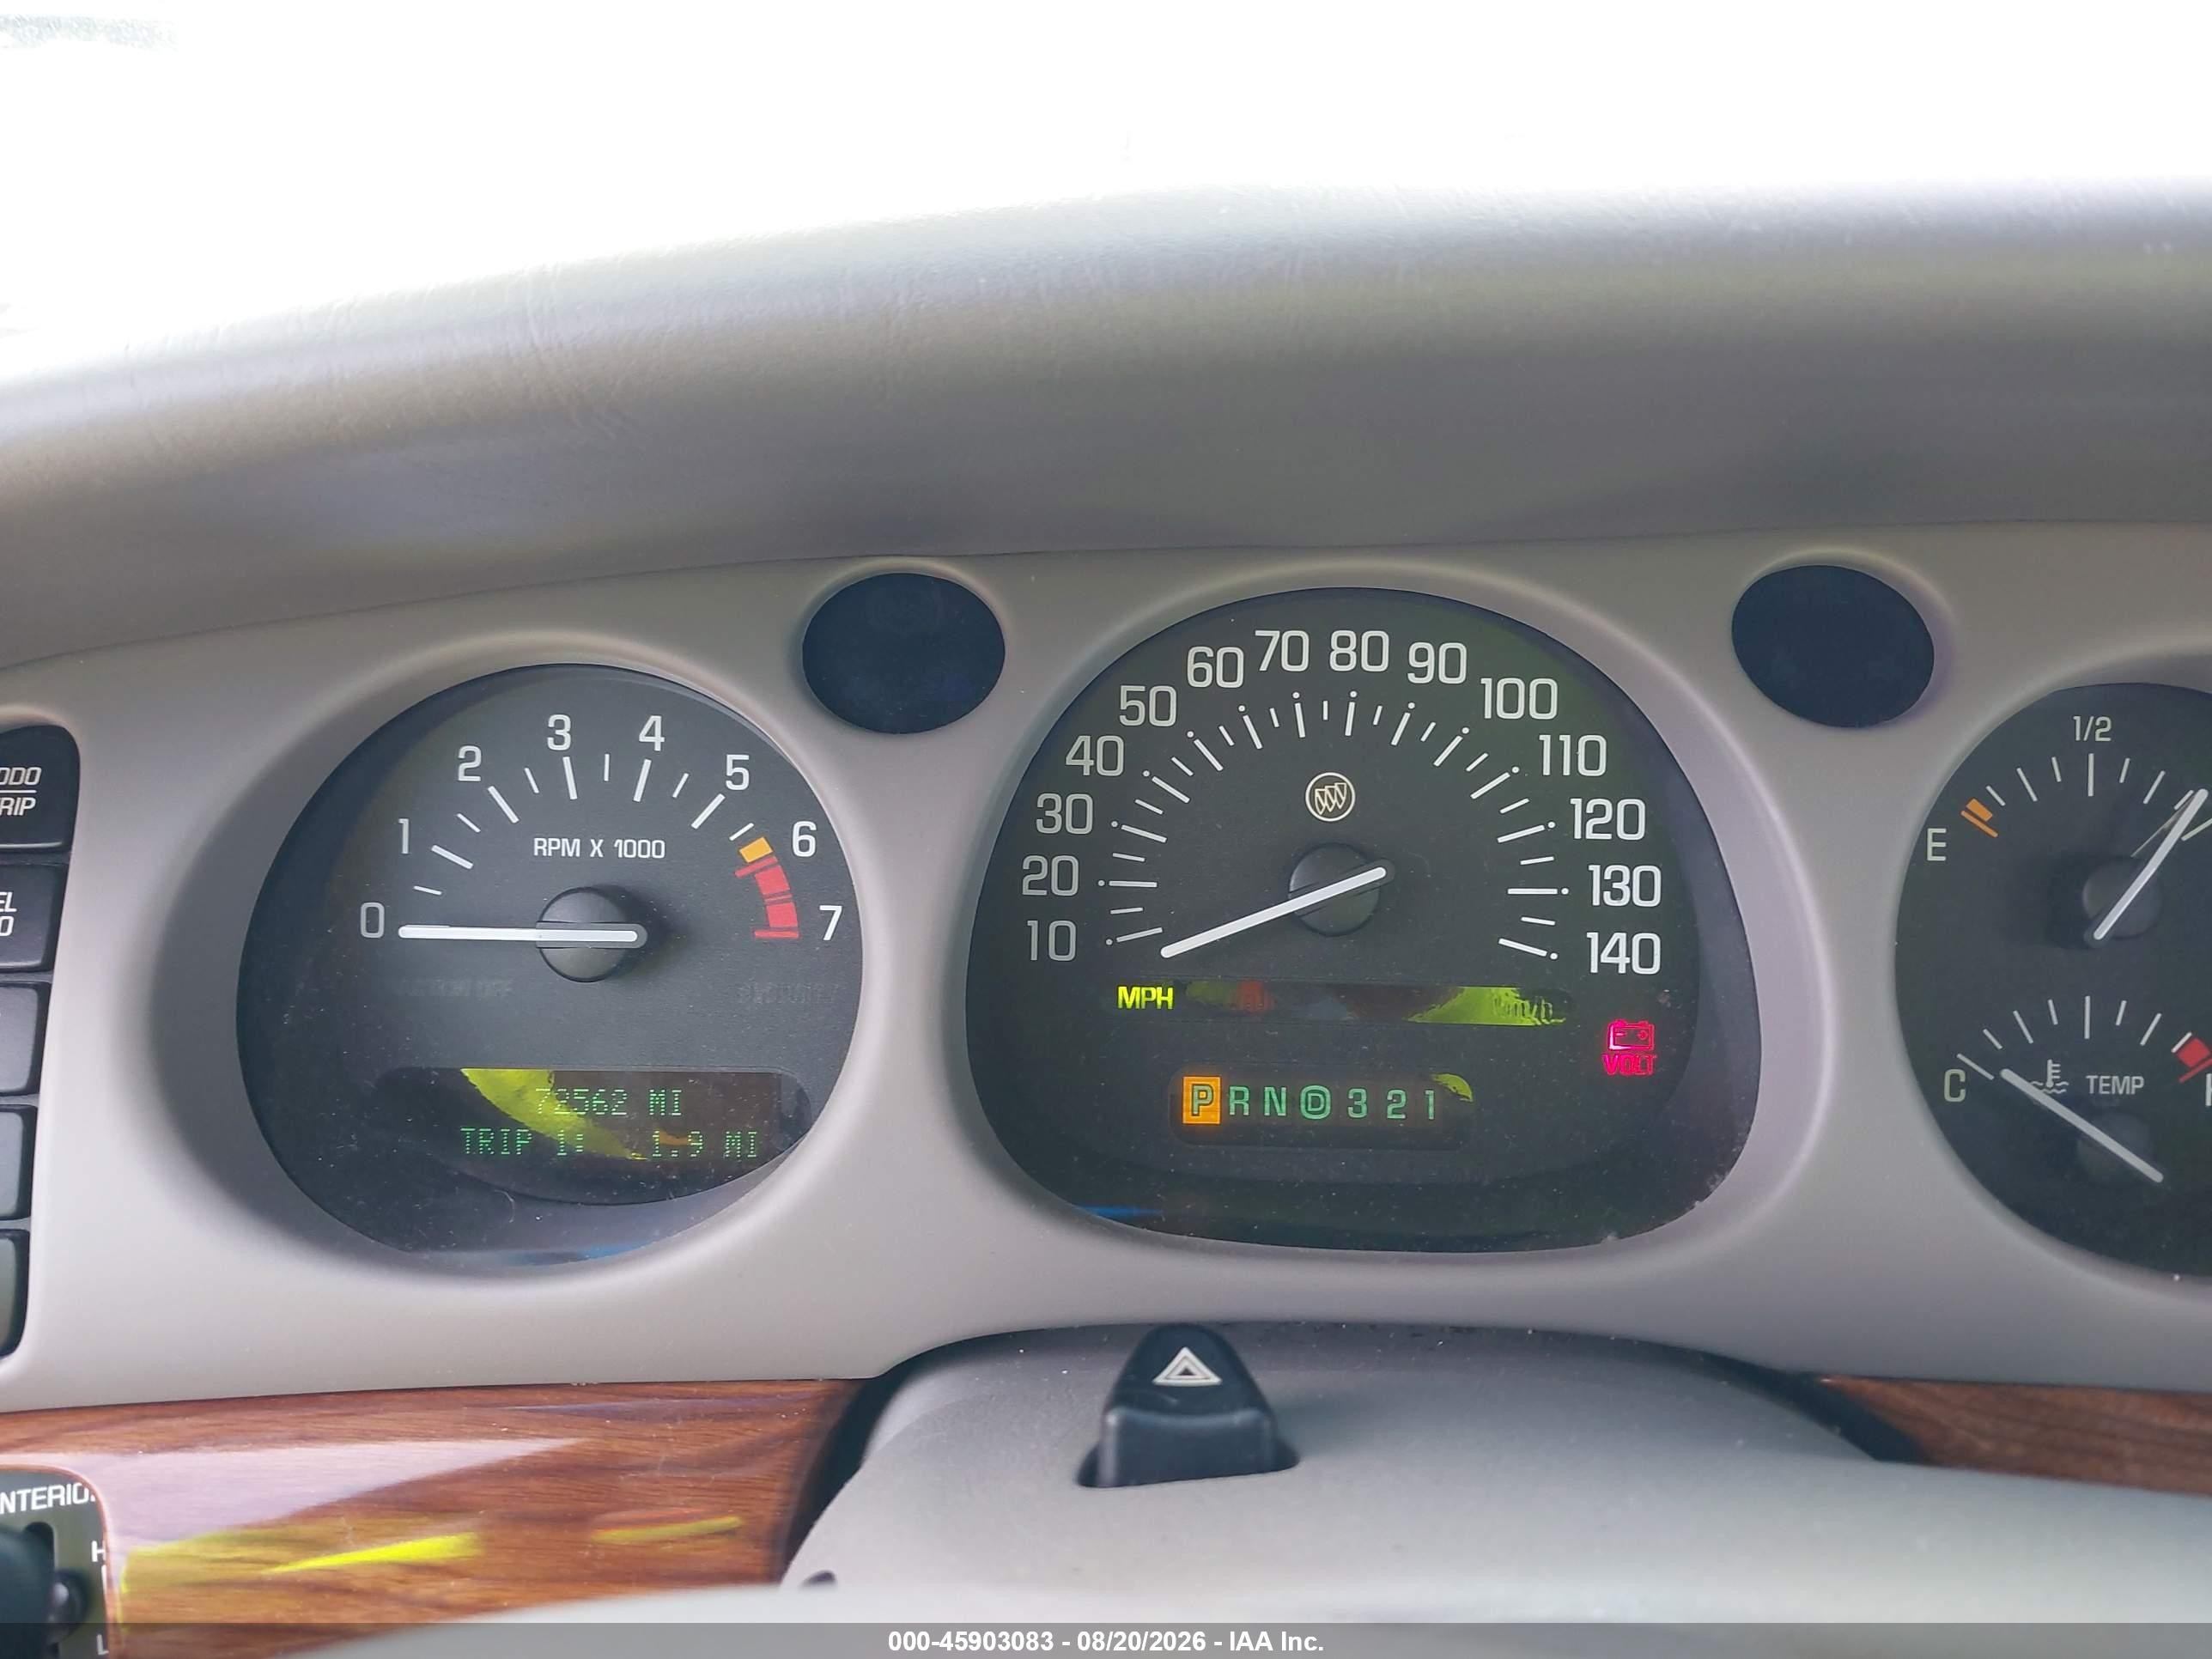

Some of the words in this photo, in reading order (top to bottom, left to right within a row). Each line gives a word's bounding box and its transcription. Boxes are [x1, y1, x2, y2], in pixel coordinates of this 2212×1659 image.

[1188, 647, 1243, 688] 60
[1255, 630, 1309, 672] 70
[1330, 630, 1389, 672] 80
[1408, 642, 1467, 684] 90
[1120, 686, 1176, 726] 50
[1481, 678, 1557, 719] 100
[548, 714, 570, 750] 3
[639, 716, 665, 750] 4
[2074, 716, 2111, 741] 1/2
[459, 746, 481, 781] 2
[726, 755, 750, 791] 5
[1066, 736, 1123, 775] 40
[1540, 735, 1606, 776] 110
[1036, 793, 1092, 834] 30
[1571, 799, 1645, 840] 120
[399, 818, 409, 854] 1
[534, 838, 580, 856] RPM
[590, 839, 603, 857] X
[614, 840, 665, 858] 1000
[793, 821, 816, 856] 6
[1928, 829, 1946, 860] E
[1023, 855, 1079, 896] 20
[1589, 865, 1661, 907] 130
[361, 902, 384, 938] 0
[820, 905, 842, 940] 7
[1028, 921, 1076, 961] 10
[1587, 933, 1660, 974] 140
[1119, 987, 1173, 1009] MPH
[1602, 1052, 1656, 1075] VOLT
[534, 1088, 627, 1116] 72562
[650, 1090, 681, 1115] MI
[1193, 1084, 1213, 1117] P
[1230, 1086, 1249, 1115] R
[1265, 1087, 1285, 1115] N
[1348, 1089, 1367, 1117] 3
[1388, 1090, 1406, 1118] 2
[1425, 1090, 1435, 1120] 1
[1944, 1069, 1966, 1102] C
[2086, 1075, 2143, 1094] TEMP
[461, 1127, 533, 1155] TRIP
[652, 1130, 703, 1158] 1.9
[726, 1132, 757, 1157] MI
